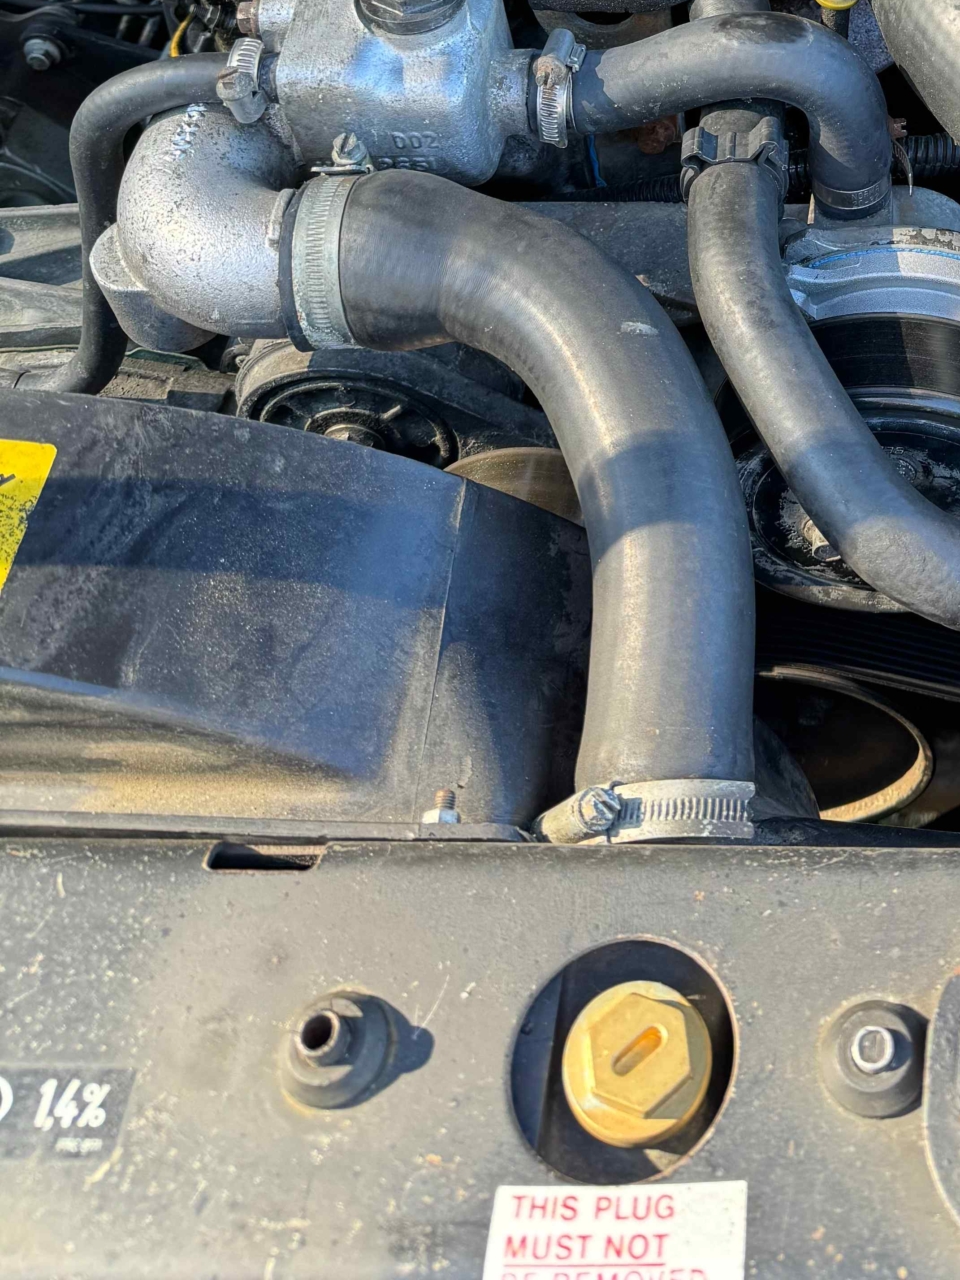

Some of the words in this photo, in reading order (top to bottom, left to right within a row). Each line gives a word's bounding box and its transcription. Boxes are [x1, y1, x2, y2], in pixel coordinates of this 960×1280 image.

[512, 1194, 580, 1221] THIS
[594, 1194, 676, 1221] PLUG
[504, 1233, 594, 1261] MUST
[603, 1232, 671, 1261] NOT
